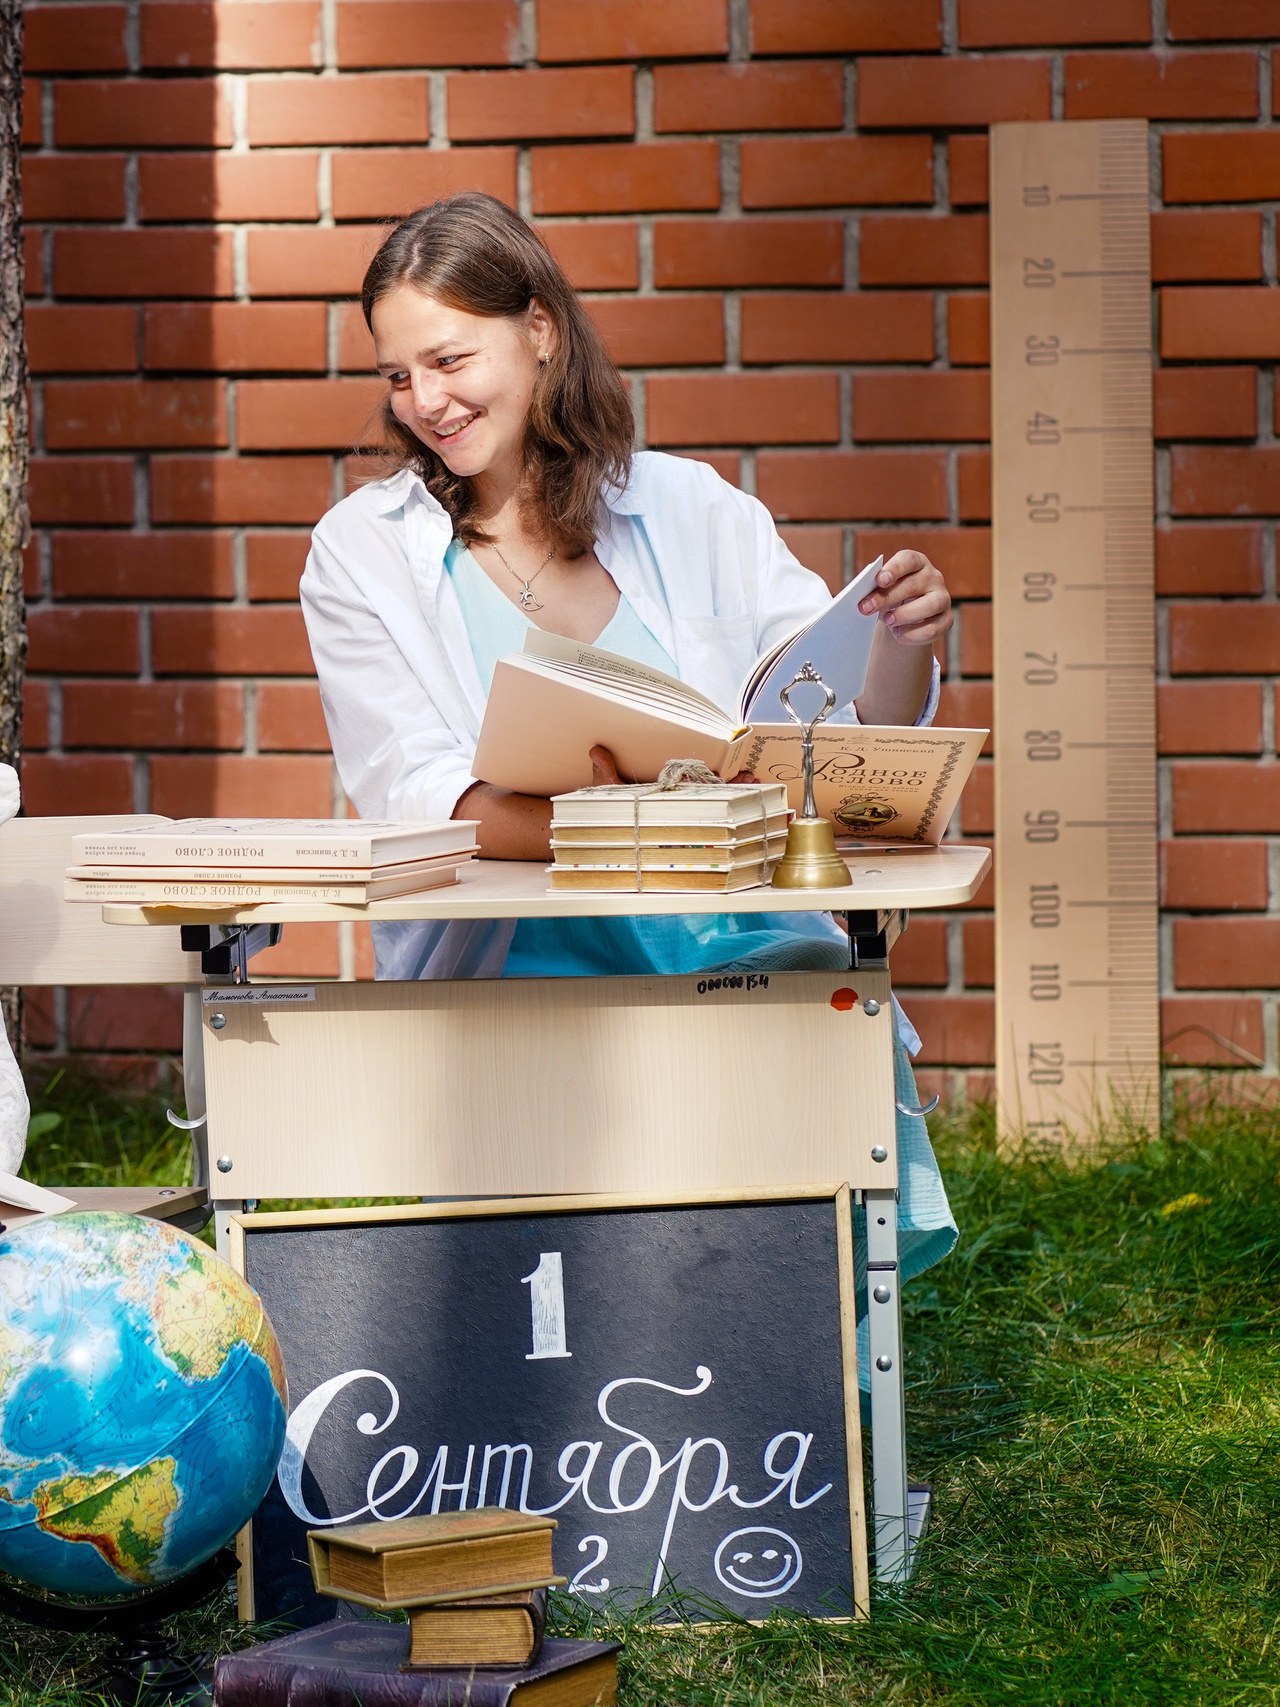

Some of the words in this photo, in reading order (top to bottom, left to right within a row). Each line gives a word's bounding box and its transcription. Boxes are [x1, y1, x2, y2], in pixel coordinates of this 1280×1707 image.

[1022, 184, 1051, 207] 10
[1022, 257, 1055, 288] 20
[1025, 335, 1060, 367] 30
[1025, 410, 1061, 446] 40
[1026, 492, 1061, 523] 50
[1023, 572, 1056, 603] 60
[1023, 651, 1058, 686] 70
[1024, 730, 1062, 762] 80
[1024, 810, 1060, 844] 90
[175, 847, 214, 857] СЛОВО
[217, 847, 264, 857] РОДНОЕ
[295, 848, 338, 857] Ушинский
[339, 848, 349, 857] Д.
[349, 849, 358, 857] К.
[163, 886, 207, 896] СЛОВО
[210, 886, 262, 897] РОДНОЕ
[273, 888, 318, 897] Ушинский
[320, 888, 330, 897] Д.
[330, 889, 341, 897] К.
[1029, 883, 1061, 929] 100
[255, 989, 309, 1000] Анастасия
[1029, 963, 1061, 1001] 110
[1028, 1040, 1064, 1086] 120
[520, 1251, 572, 1360] 1
[276, 1365, 833, 1598] Сентября
